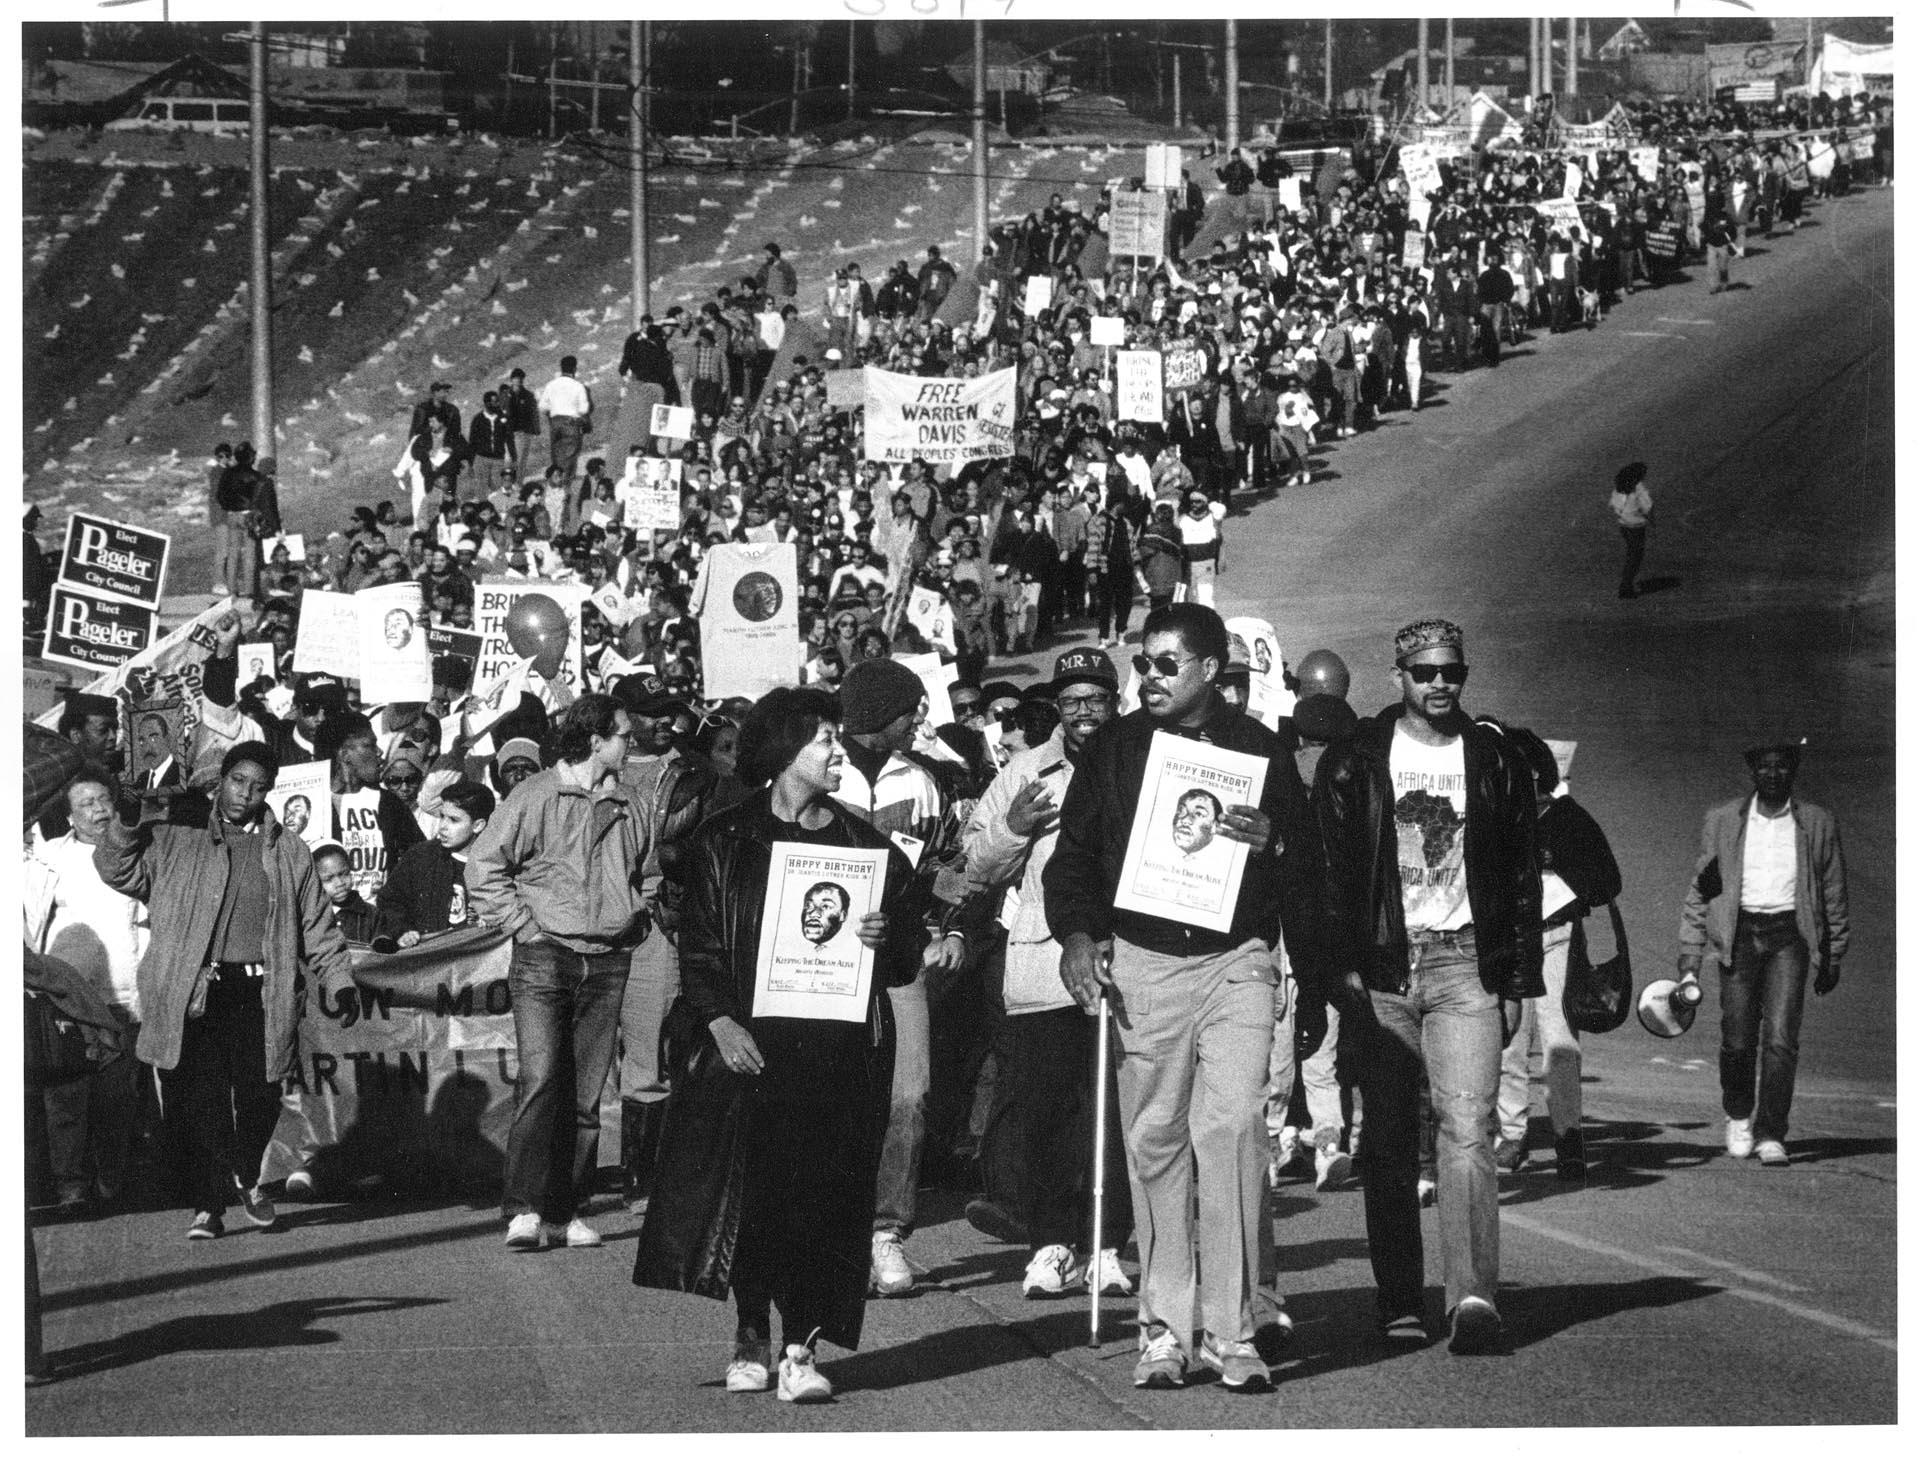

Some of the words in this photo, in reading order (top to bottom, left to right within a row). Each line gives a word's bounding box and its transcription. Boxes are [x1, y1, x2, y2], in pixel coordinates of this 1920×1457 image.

[916, 383, 966, 404] FREE
[902, 402, 979, 422] WARREN
[918, 423, 967, 445] DAVIS
[885, 447, 906, 460] ALL
[115, 530, 138, 544] Elect
[72, 523, 151, 577] Pageler
[85, 571, 105, 587] City
[106, 577, 141, 595] Council
[96, 602, 120, 615] Elect
[56, 596, 138, 646] Pageler
[430, 631, 452, 643] Elect
[70, 645, 88, 659] City
[89, 649, 128, 664] Council
[1060, 654, 1087, 672] MR.
[1090, 655, 1102, 667] V
[1165, 761, 1198, 775] HAPPY
[1200, 769, 1248, 788] BIRTHDAY
[1397, 771, 1435, 791] AFRICA
[788, 858, 821, 869] HAPPY
[824, 861, 873, 874] BIRTHDAY
[283, 1050, 430, 1097] ARTIN
